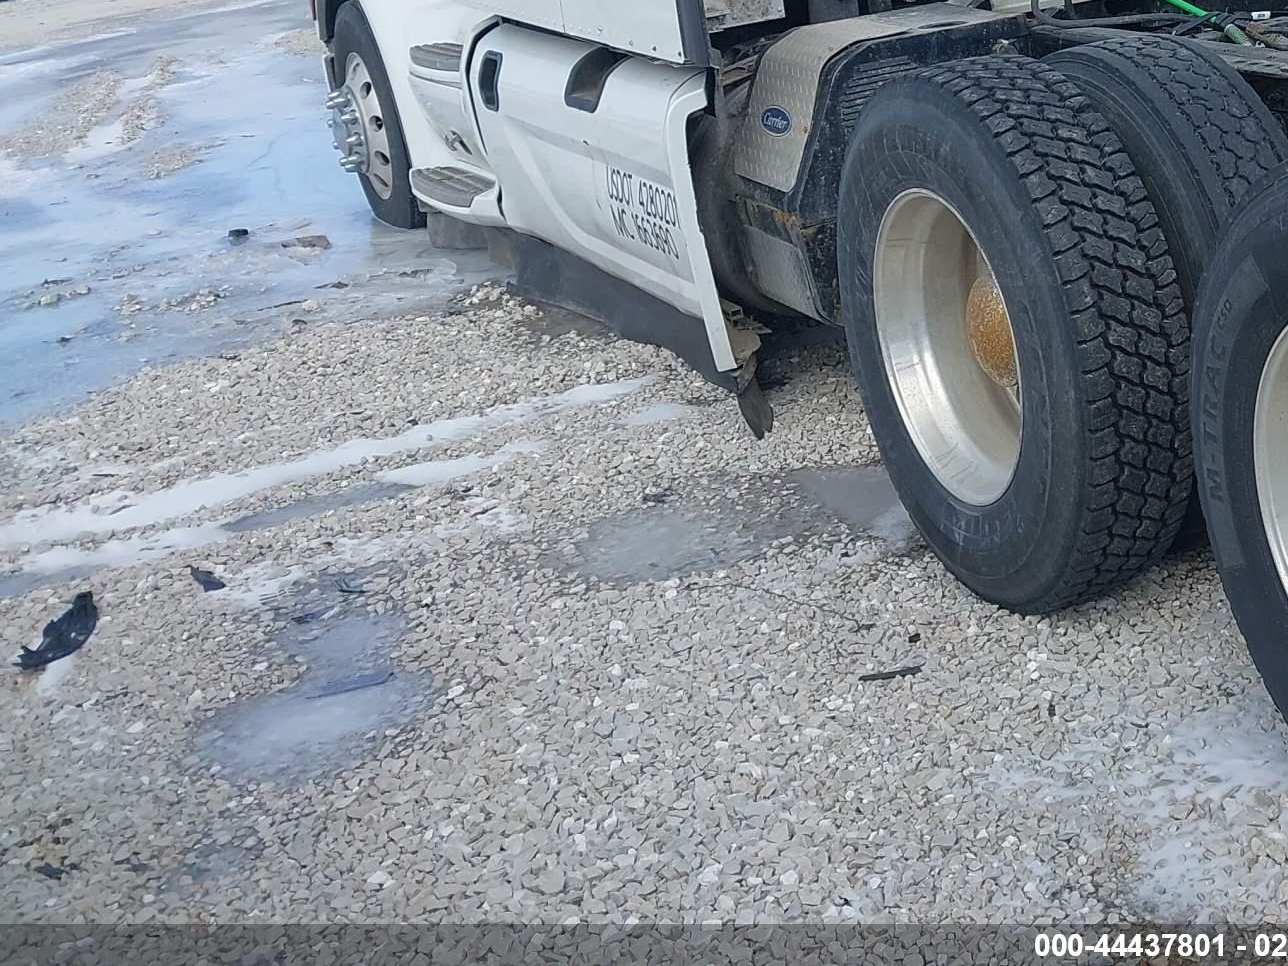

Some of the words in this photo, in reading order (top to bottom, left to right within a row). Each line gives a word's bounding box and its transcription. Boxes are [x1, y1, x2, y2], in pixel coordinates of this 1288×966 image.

[763, 112, 789, 129] Carrier
[606, 165, 635, 209] USDOT
[638, 179, 681, 230] 4280201
[610, 203, 635, 240] MC
[1201, 333, 1227, 504] M-TRAC
[1216, 297, 1233, 330] CSD
